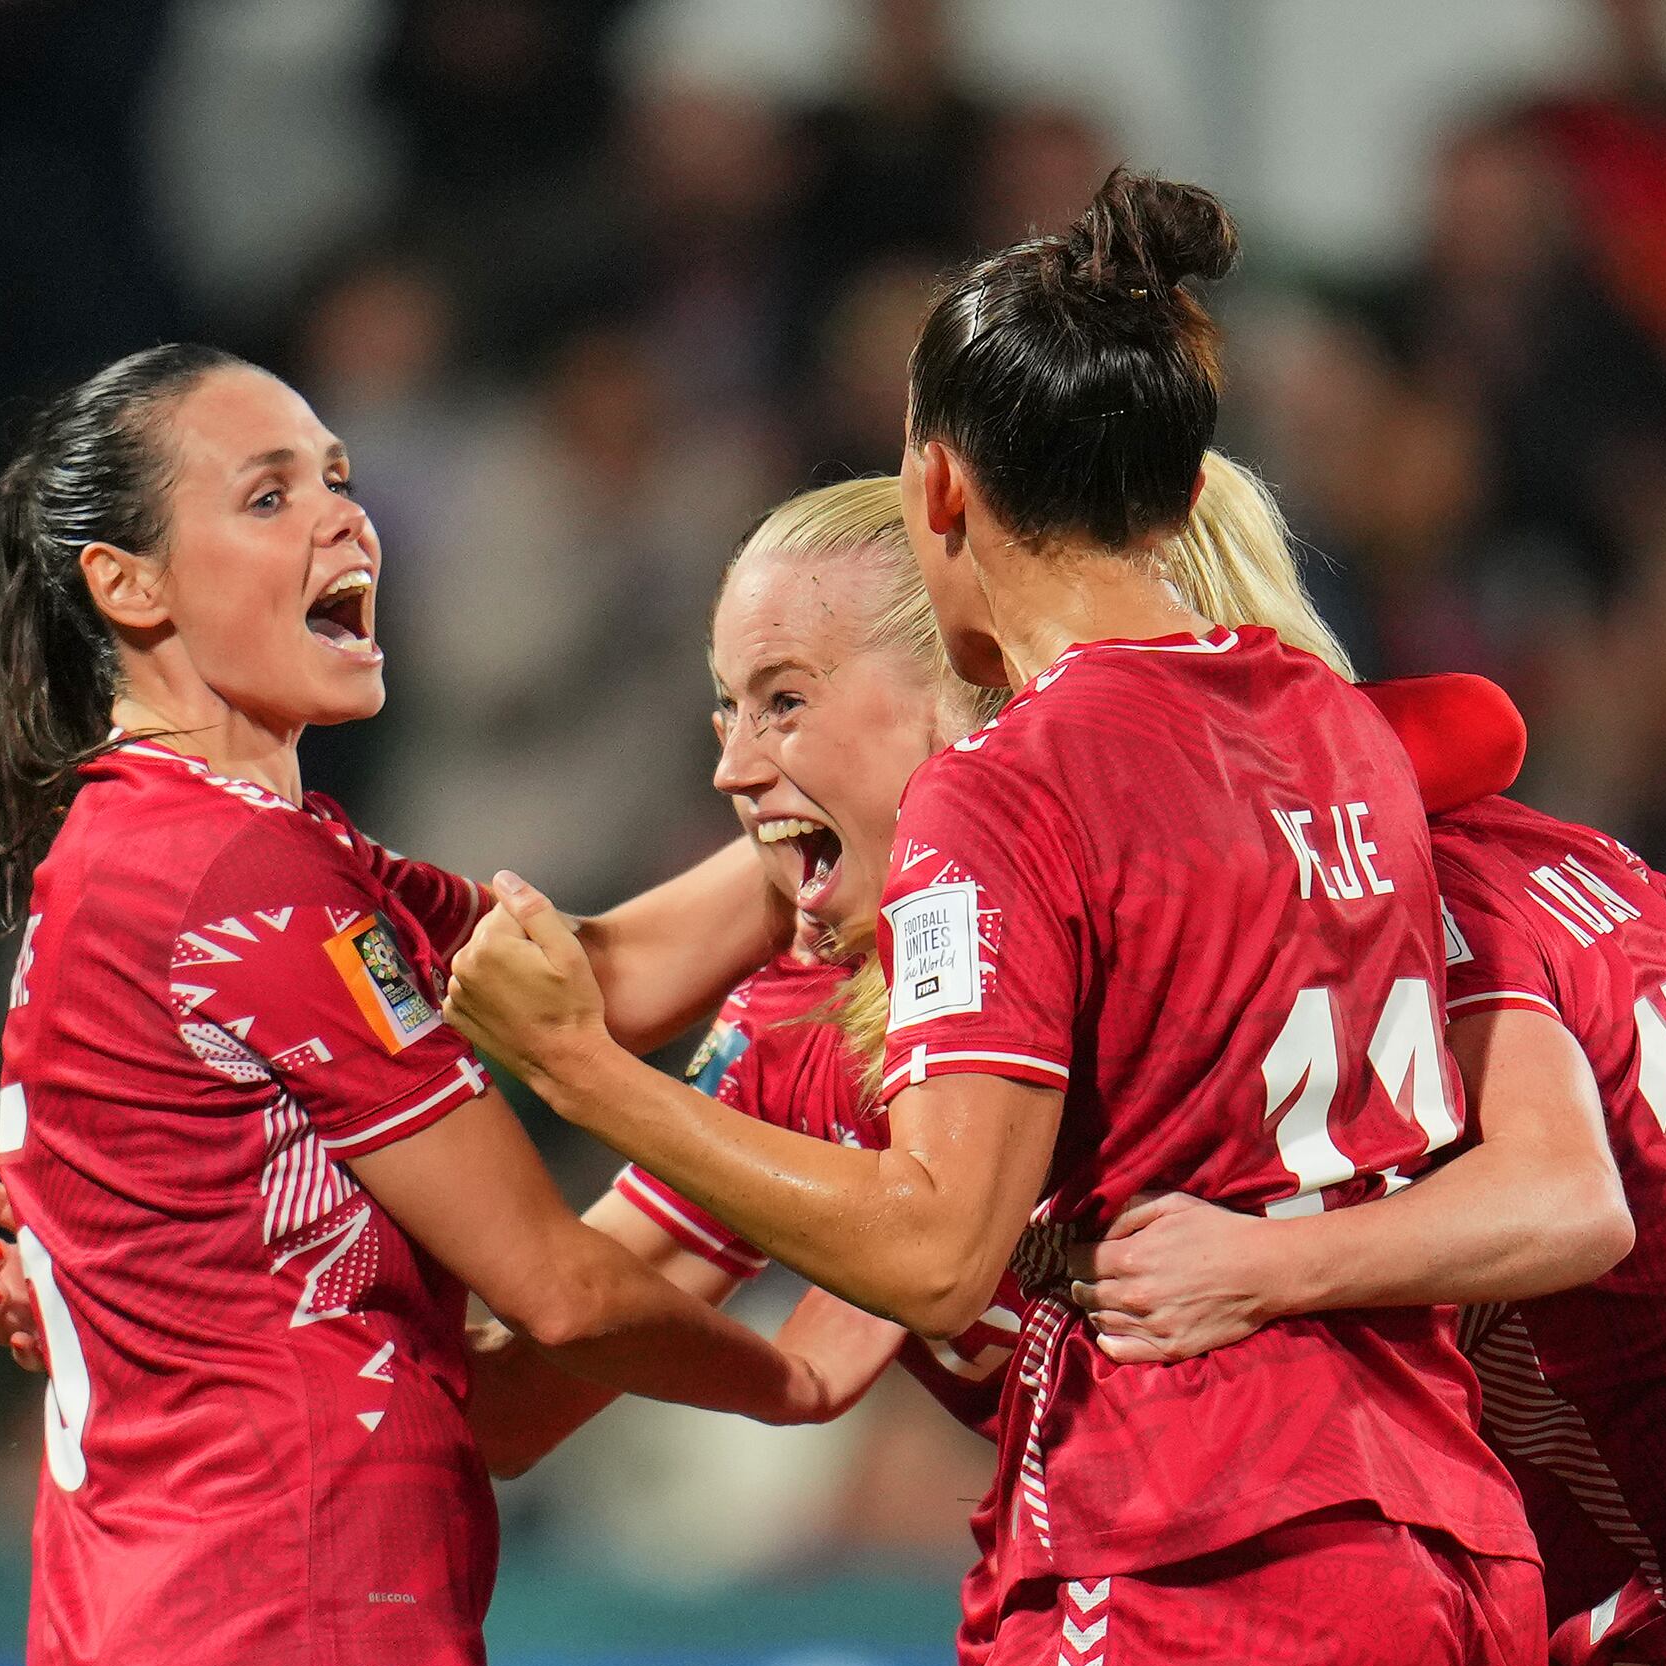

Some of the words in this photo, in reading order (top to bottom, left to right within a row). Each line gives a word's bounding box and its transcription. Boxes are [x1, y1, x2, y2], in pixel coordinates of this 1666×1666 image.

[904, 908, 950, 938] FOOTBALL
[906, 926, 951, 960] UNITES
[918, 948, 956, 976] World
[916, 978, 938, 999] FIFA
[397, 1004, 414, 1020] AU
[1261, 978, 1458, 1220] 11
